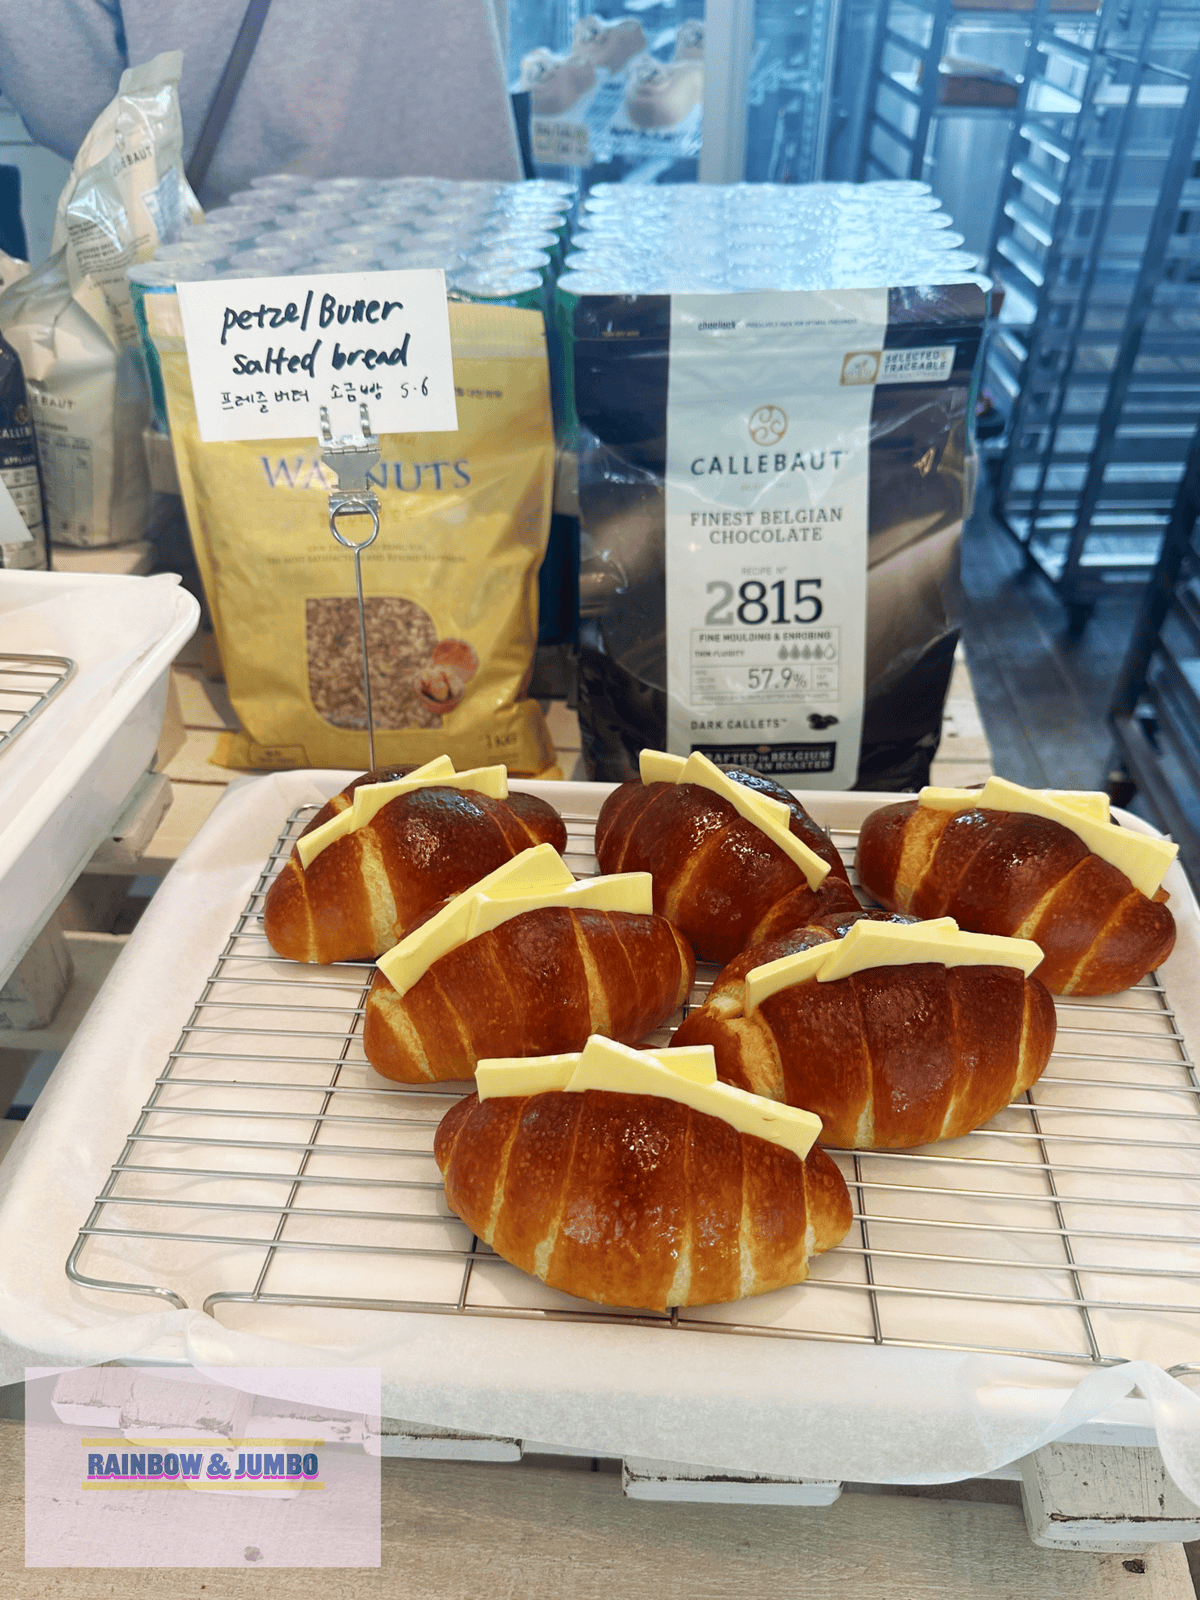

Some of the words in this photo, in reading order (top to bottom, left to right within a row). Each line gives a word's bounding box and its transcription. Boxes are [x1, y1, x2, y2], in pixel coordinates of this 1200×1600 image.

[232, 338, 323, 378] salted
[331, 333, 411, 371] bread
[274, 389, 310, 402] 버터
[690, 450, 843, 476] CALLEBAUT
[261, 456, 471, 492] WANUTS
[690, 511, 754, 526] FINEST
[760, 507, 843, 525] BELGIAN
[709, 526, 823, 544] CHOCOLATE
[704, 578, 823, 626] 2815
[699, 633, 720, 642] FINE
[723, 631, 772, 642] MOULDING
[774, 631, 781, 641] &
[783, 630, 831, 641] ENROBING
[748, 667, 807, 690] 57.9%
[690, 719, 723, 730] DARK
[706, 753, 758, 764] RAFTED
[771, 751, 831, 763] BELGIUM
